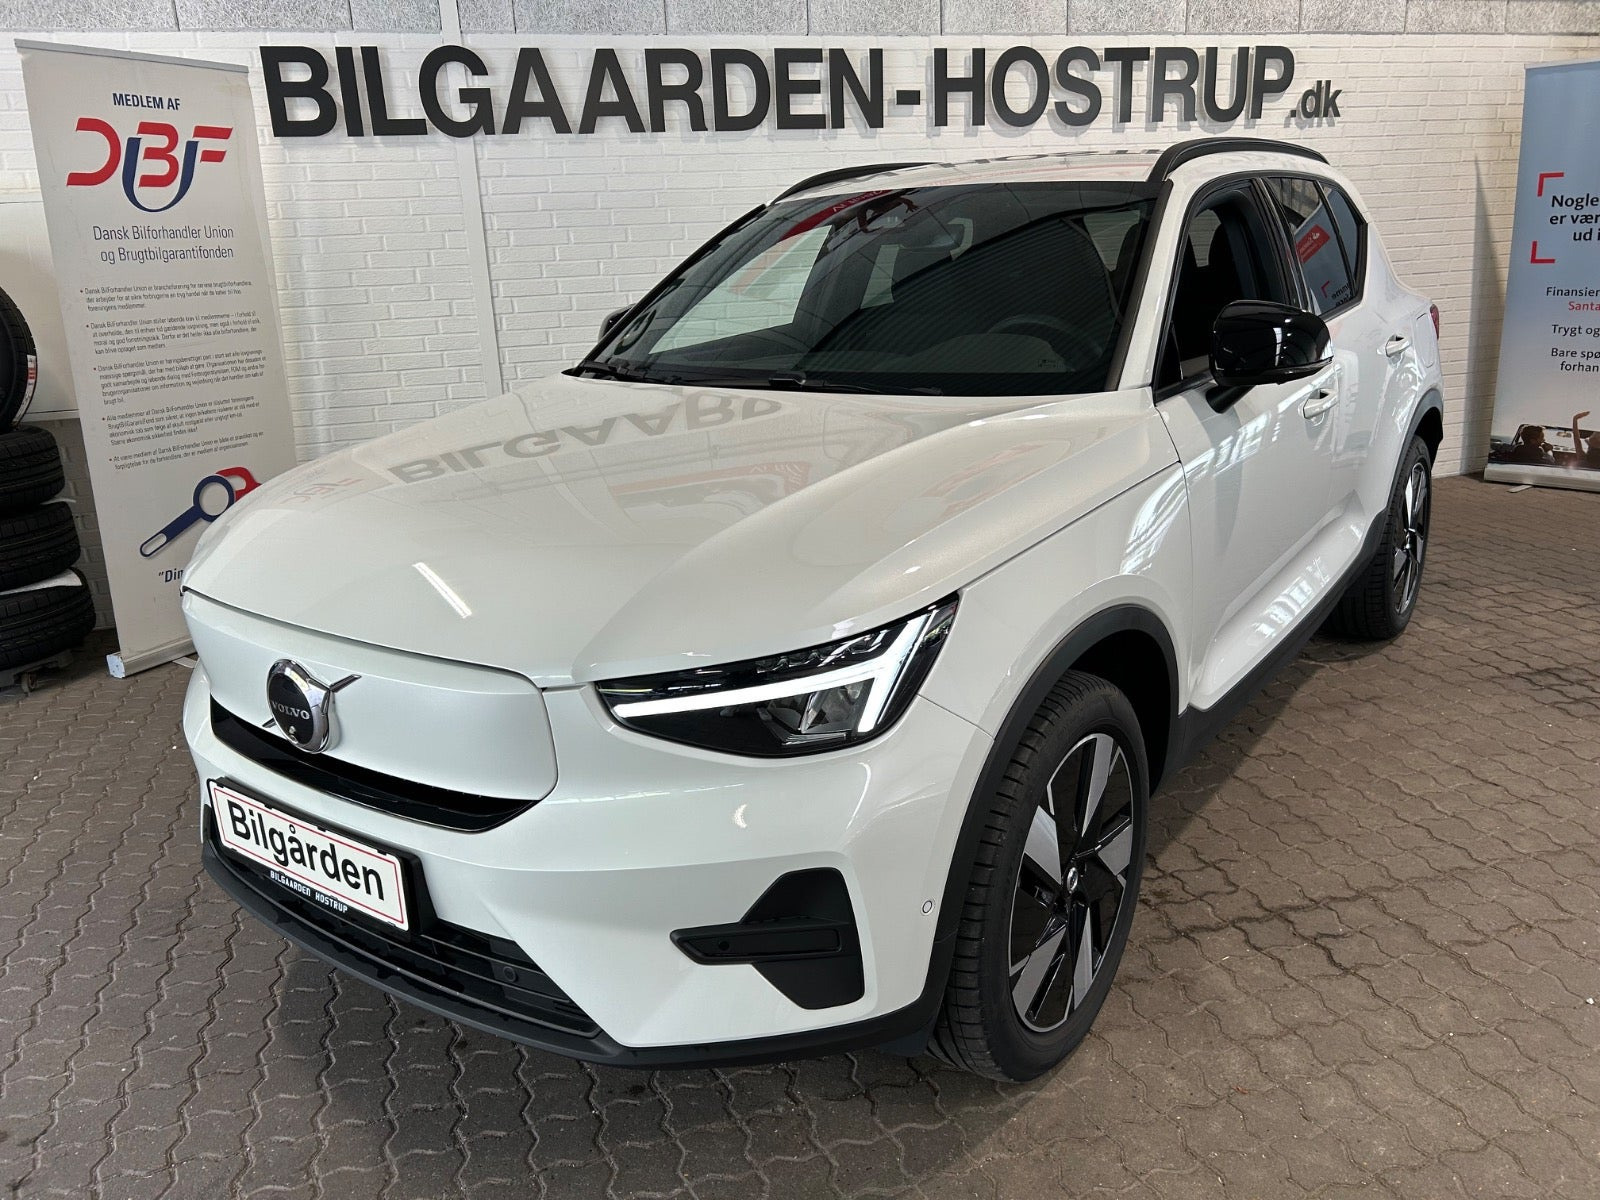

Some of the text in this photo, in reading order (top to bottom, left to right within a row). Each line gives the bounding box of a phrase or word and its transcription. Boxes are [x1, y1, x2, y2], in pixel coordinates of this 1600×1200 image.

[112, 92, 181, 111] MEDLEM AF
[1551, 193, 1599, 210] Nogle
[1549, 215, 1566, 224] er
[93, 225, 234, 241] Dansk Bilforhandler Union
[1573, 229, 1593, 241] ud
[100, 245, 234, 264] og Brugtbilgarantifonden
[1551, 324, 1600, 338] Trygt og
[1551, 348, 1577, 358] Bare
[1560, 361, 1599, 373] forhan
[272, 700, 311, 721] VOLVO
[227, 799, 385, 901] Bilgården
[270, 870, 348, 914] BILGAARDEN HOSTRUP
